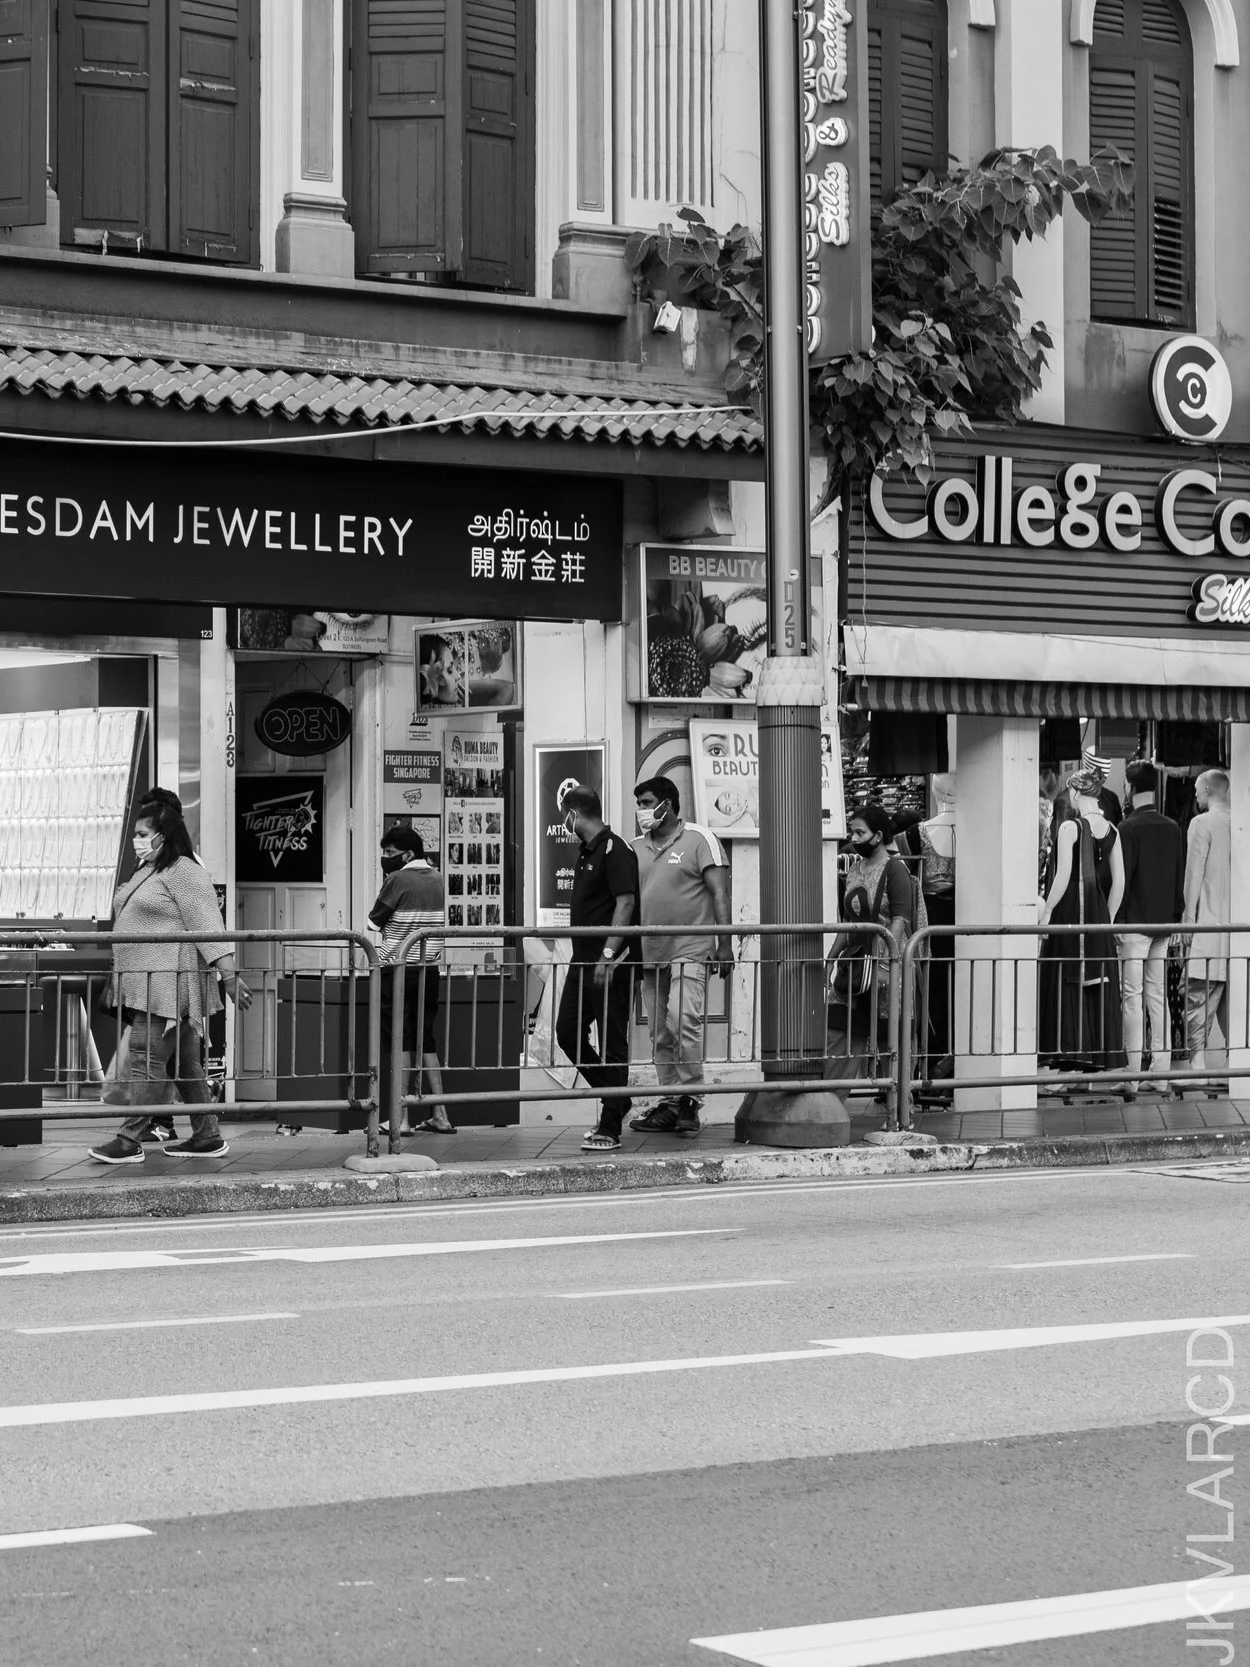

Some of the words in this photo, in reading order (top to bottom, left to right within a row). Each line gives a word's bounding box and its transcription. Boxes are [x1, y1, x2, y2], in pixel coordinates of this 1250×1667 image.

[818, 0, 847, 102] Ready
[819, 162, 846, 245] Silks
[868, 455, 1142, 551] College
[173, 504, 413, 556] JEWELLERY
[468, 508, 590, 545] அதிர்ஷ்டம்
[471, 546, 586, 583] 開新金莊
[669, 556, 691, 575] BB
[696, 558, 757, 578] BEAUTY
[201, 630, 213, 638] 123
[263, 707, 340, 742] OPEN
[385, 755, 412, 767] FIGHTER
[413, 755, 440, 767] FITNESS
[479, 741, 499, 755] BEAUTY
[393, 767, 431, 779] SINGAPORE
[713, 760, 757, 776] BEAUT
